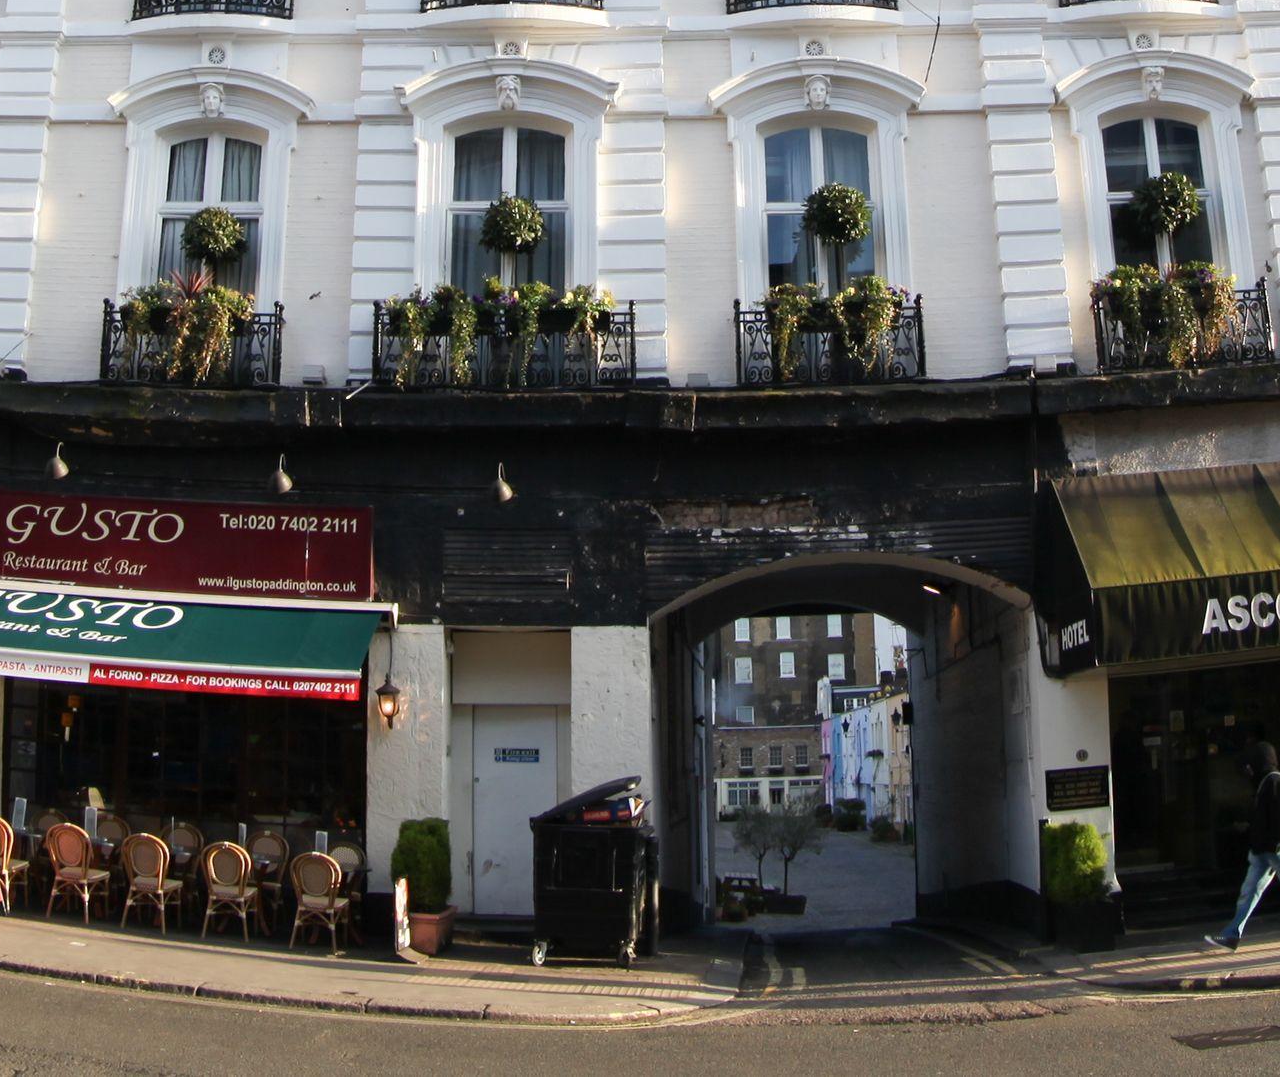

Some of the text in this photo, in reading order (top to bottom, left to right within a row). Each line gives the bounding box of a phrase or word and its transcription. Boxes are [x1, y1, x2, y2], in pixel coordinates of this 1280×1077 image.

[5, 502, 185, 545] GUSTO
[220, 513, 358, 534] Tel:020 7402 2111
[3, 550, 88, 573] Restaurant
[93, 556, 112, 575] &
[115, 560, 147, 577] Bar
[198, 576, 357, 593] www.ilgustopaddington.co.uk
[46, 622, 78, 640] &
[79, 630, 128, 645] Bar
[1061, 619, 1090, 651] HOTEL
[34, 663, 83, 676] ANTIPASTI
[93, 667, 107, 679] AL
[108, 669, 144, 682] FORNO
[150, 673, 179, 685] PIZZA
[186, 675, 207, 687] FOR
[209, 676, 263, 690] BOOKINGS
[264, 679, 291, 691] CALL
[292, 681, 332, 693] 0207402
[333, 683, 356, 695] 2111
